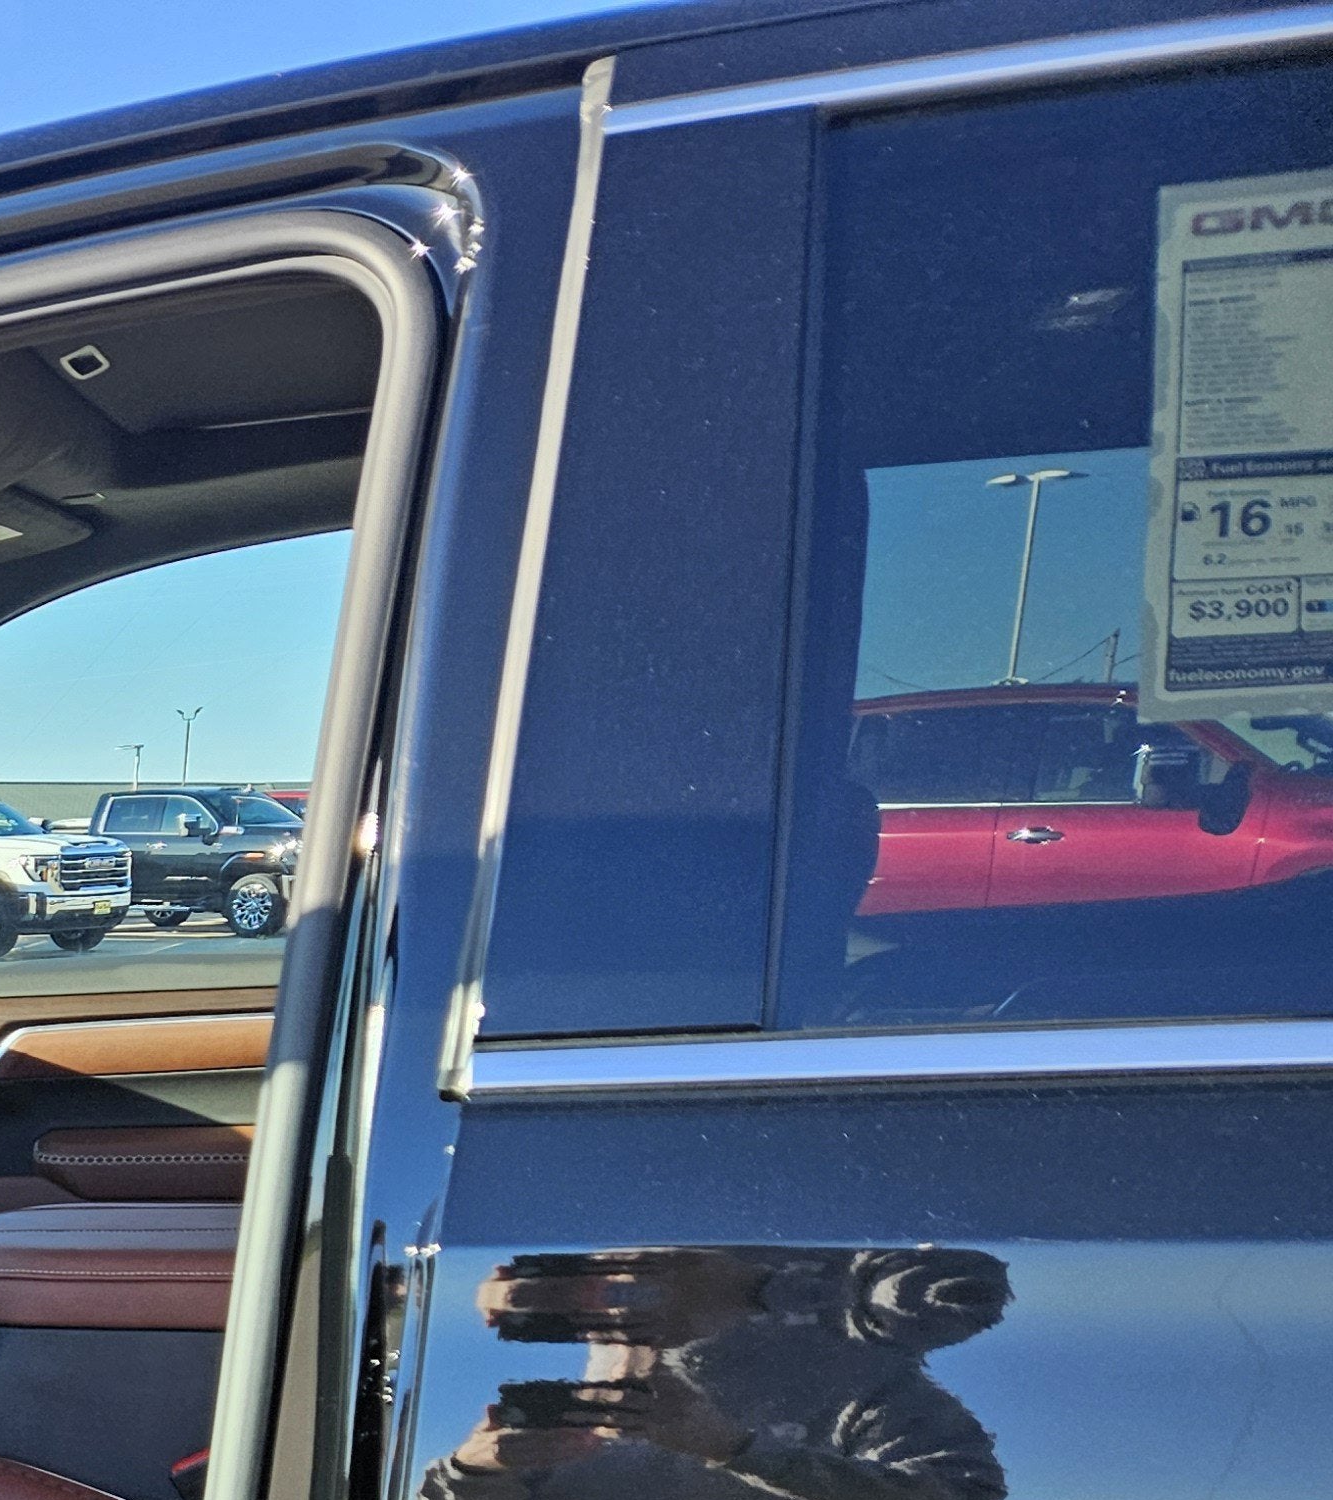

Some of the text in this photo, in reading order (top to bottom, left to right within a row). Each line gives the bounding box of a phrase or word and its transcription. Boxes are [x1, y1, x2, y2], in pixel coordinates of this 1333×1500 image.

[1210, 499, 1271, 538] 16
[1245, 580, 1294, 595] cost
[1188, 597, 1290, 622] $3,900
[1168, 665, 1326, 683] fueleconomy.gov
